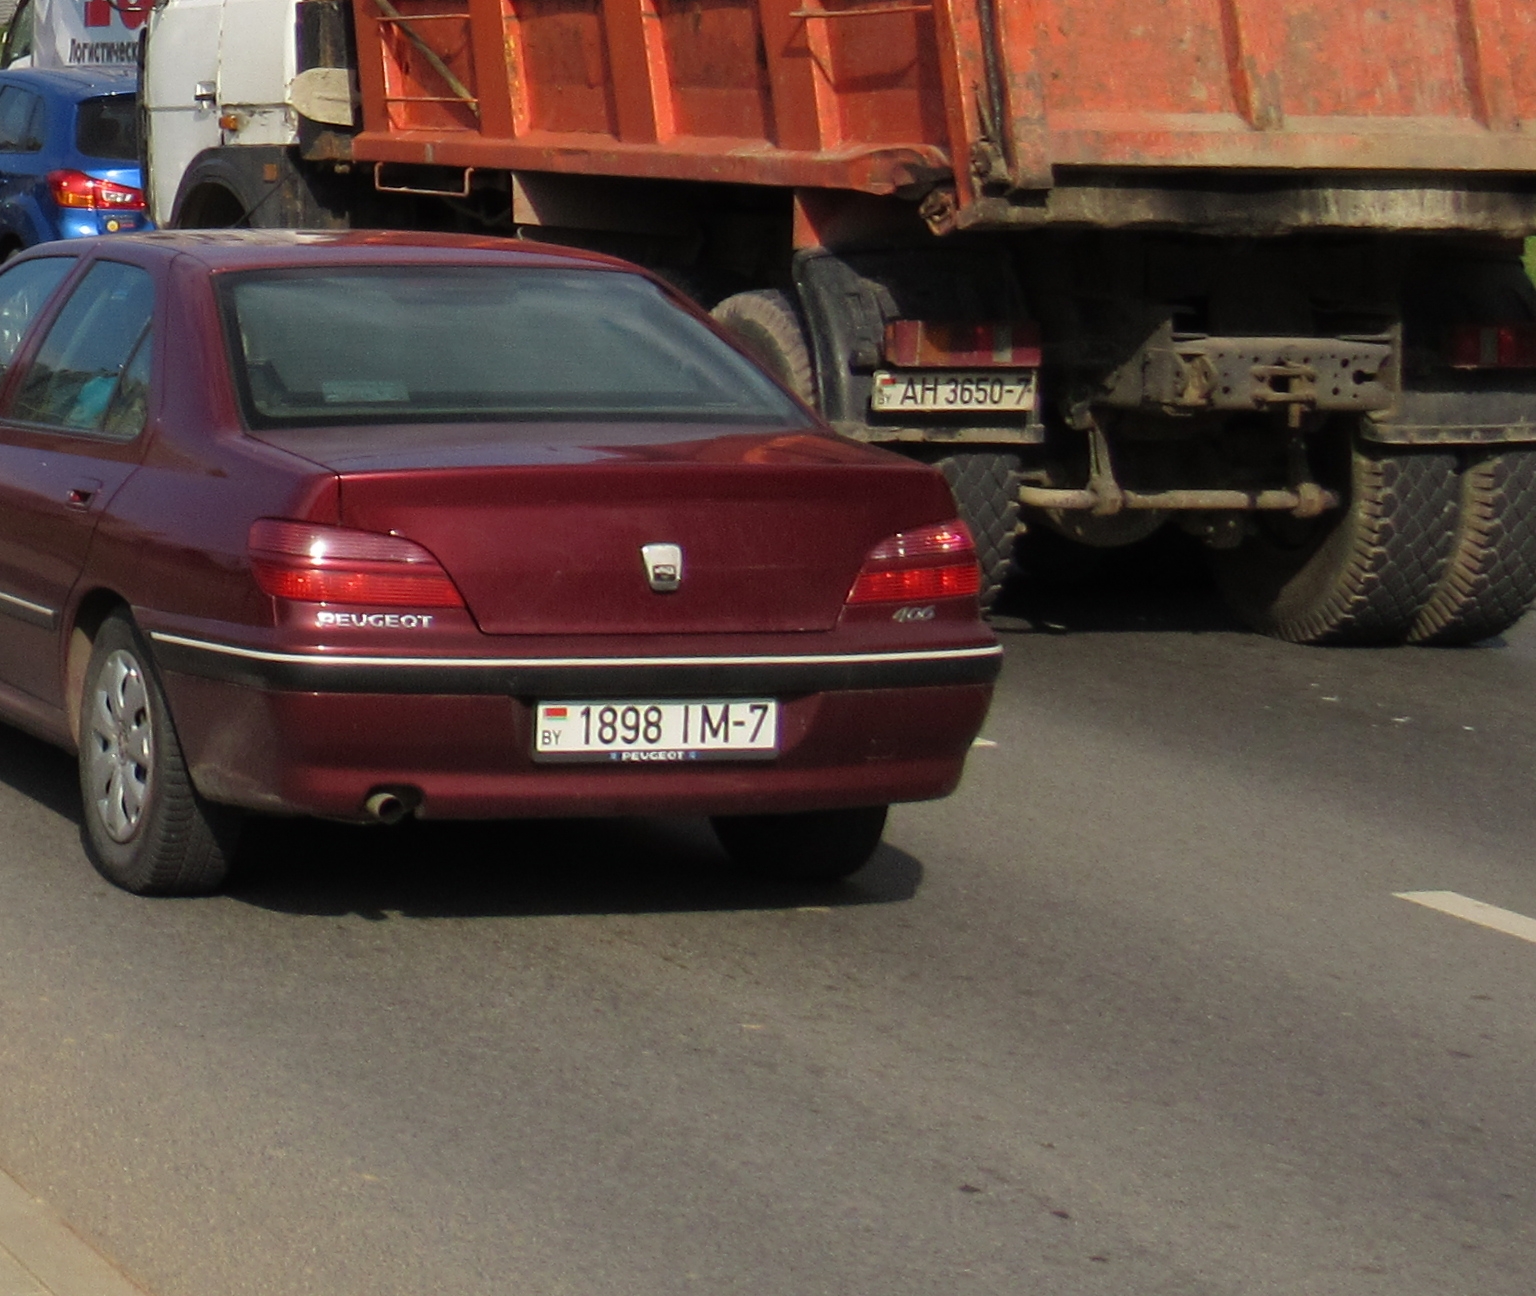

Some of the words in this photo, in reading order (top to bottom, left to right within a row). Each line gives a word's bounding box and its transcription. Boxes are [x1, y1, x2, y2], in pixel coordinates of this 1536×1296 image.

[899, 376, 939, 405] AH
[315, 611, 433, 628] PEUGEOT
[580, 705, 663, 746] 1898
[541, 729, 563, 746] BY
[621, 750, 685, 761] PEUGEOT
